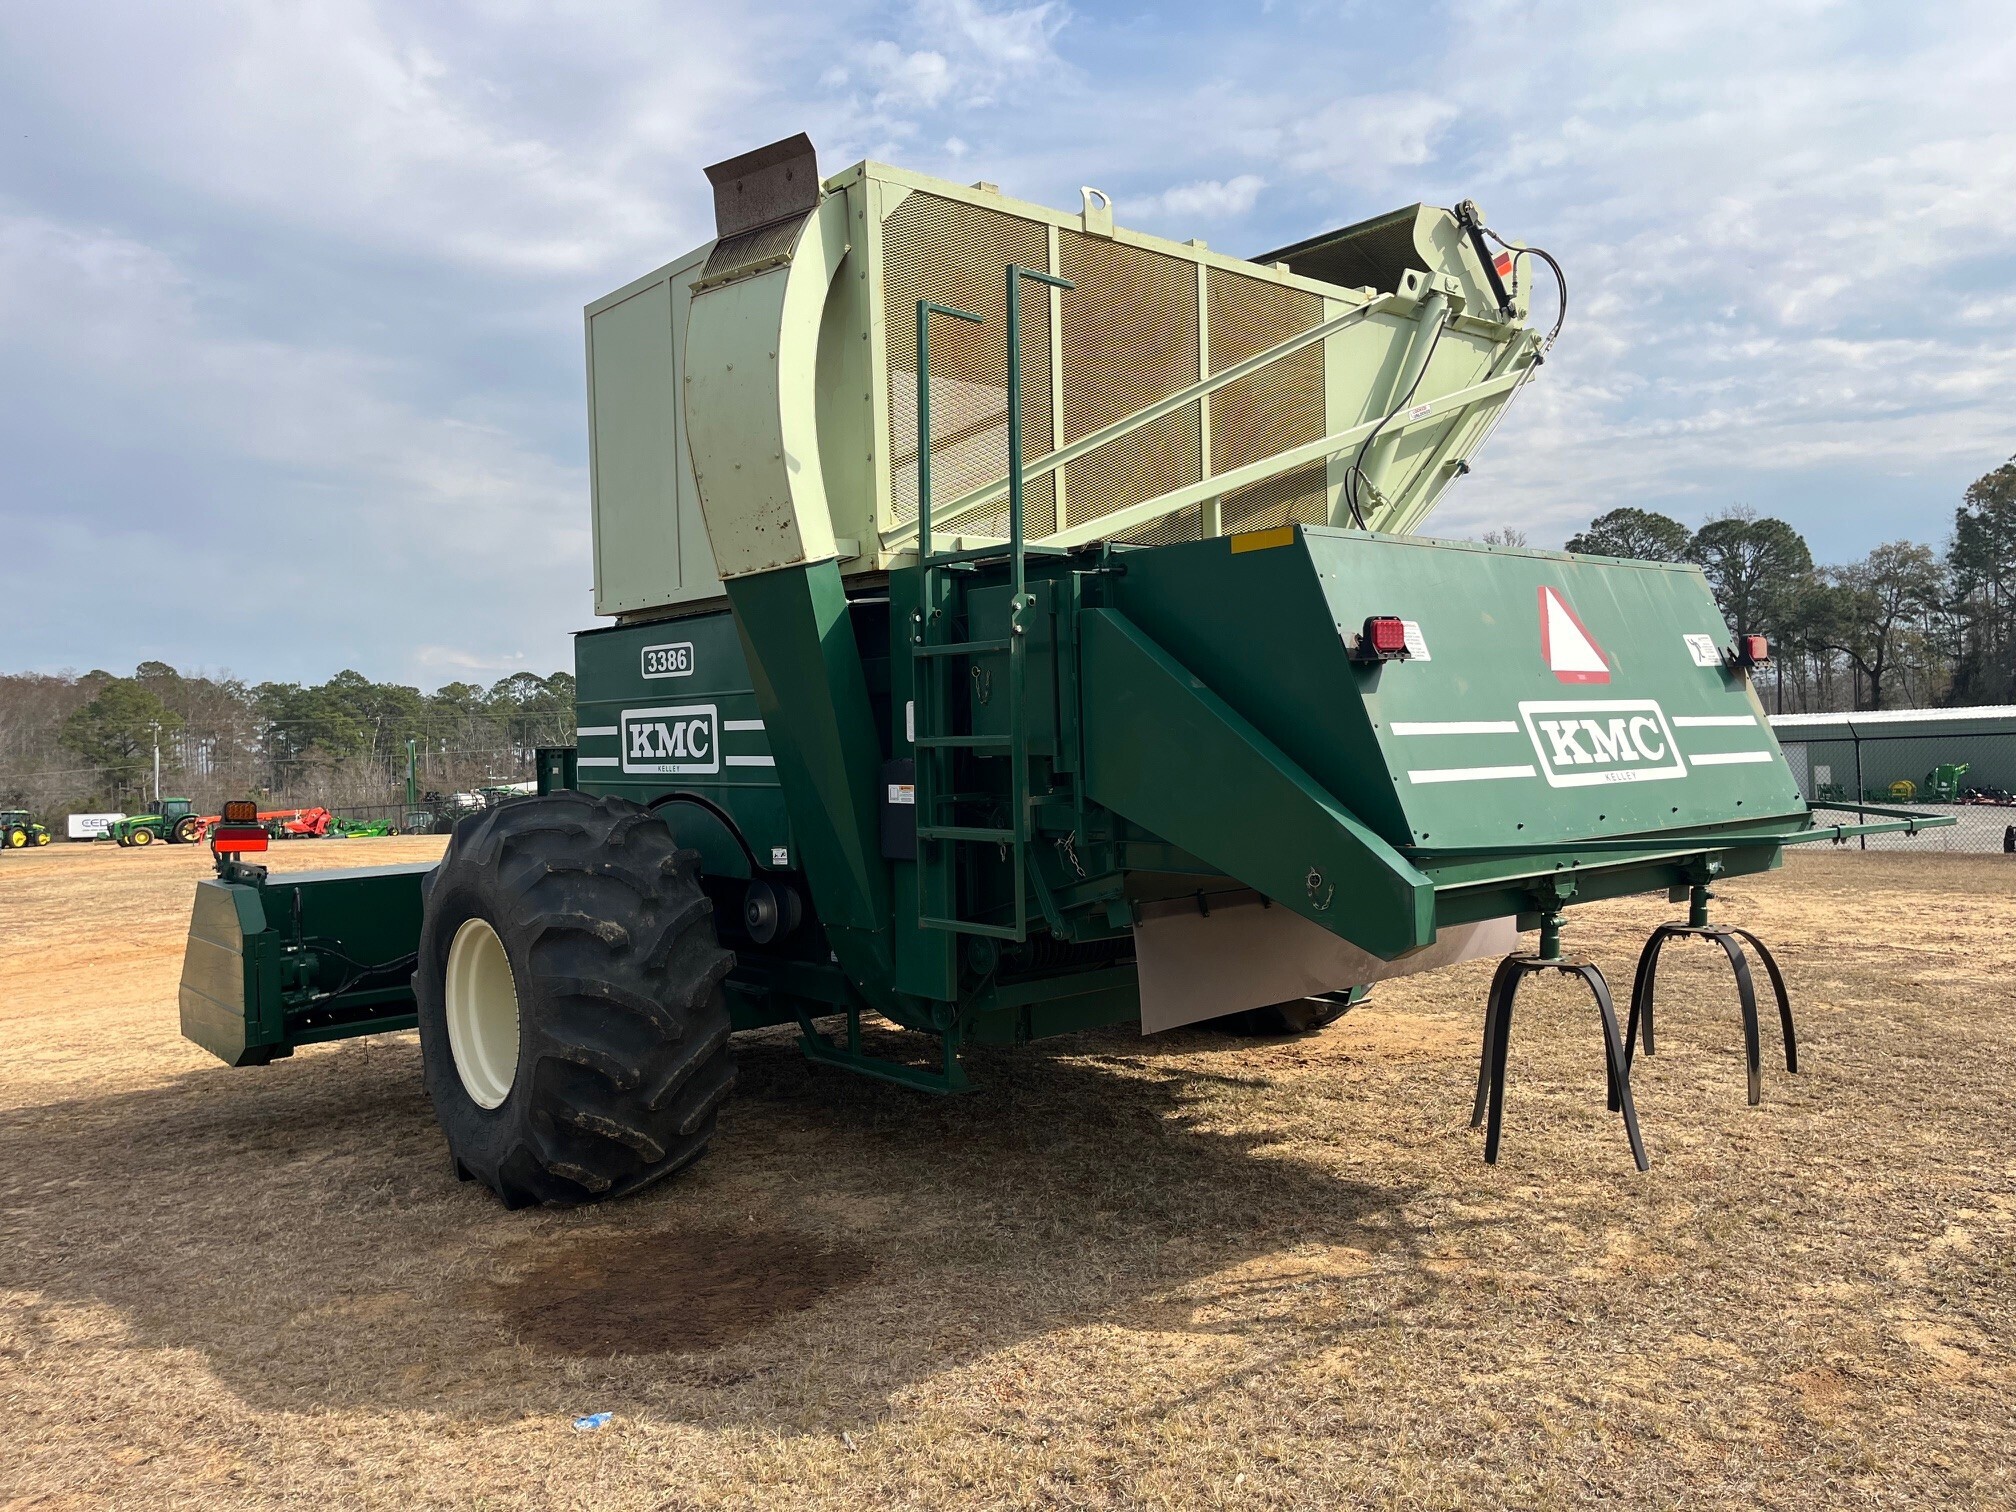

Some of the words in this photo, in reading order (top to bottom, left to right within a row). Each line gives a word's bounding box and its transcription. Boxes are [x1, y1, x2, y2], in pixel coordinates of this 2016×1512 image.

[648, 649, 687, 672] 3386
[629, 719, 709, 758] KMC
[1538, 716, 1665, 766] KMC
[1605, 772, 1637, 782] KELLEY
